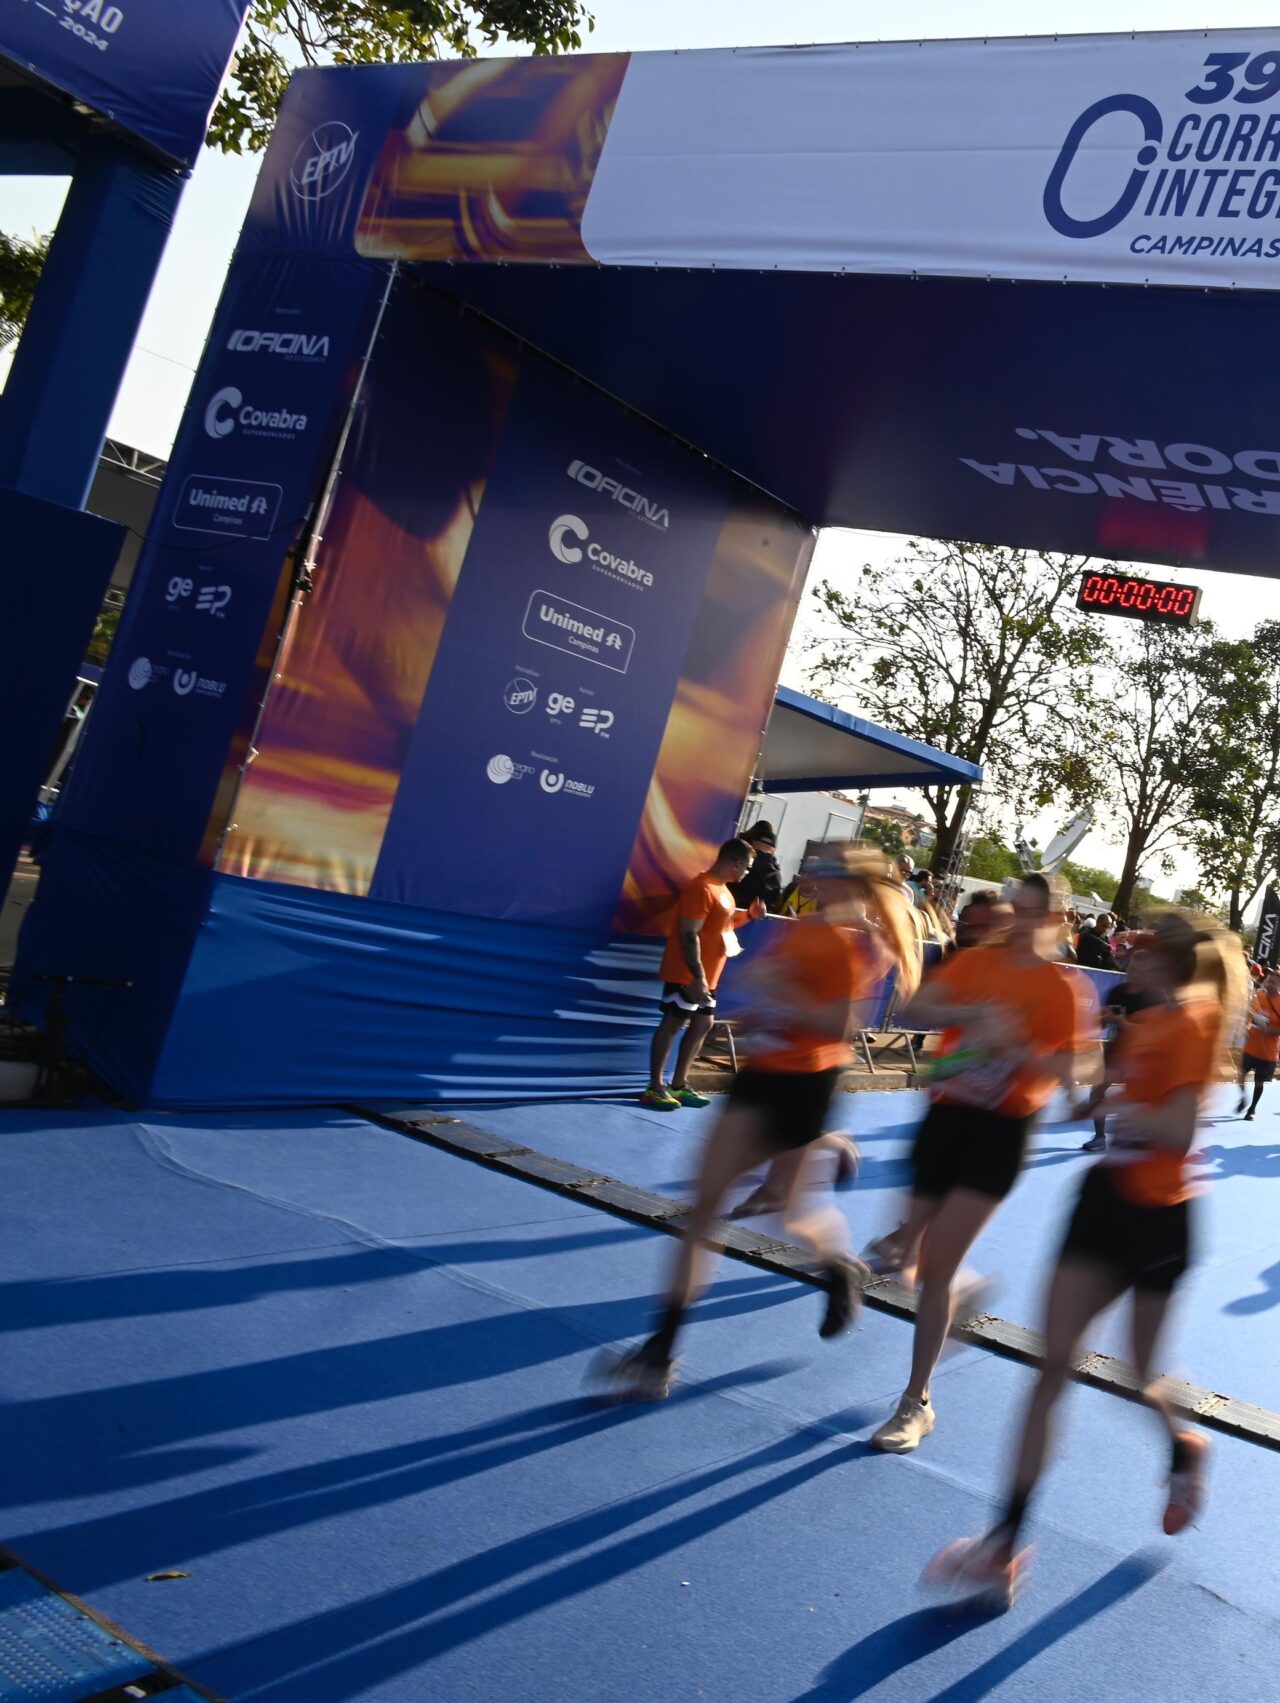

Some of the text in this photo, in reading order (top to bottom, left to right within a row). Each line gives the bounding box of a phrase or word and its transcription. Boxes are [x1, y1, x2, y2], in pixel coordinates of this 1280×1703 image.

[59, 16, 109, 51] 2024
[301, 131, 359, 185] EPTV
[227, 329, 330, 357] OFICINA
[239, 405, 308, 431] Covabra
[189, 489, 250, 512] Unimed
[567, 459, 669, 528] OFICINA
[587, 543, 654, 586] Covabra
[165, 576, 194, 602] ge
[1083, 576, 1194, 615] 00:00:00
[540, 604, 604, 642] Unimed
[510, 688, 538, 704] EPTV
[545, 692, 575, 715] ge
